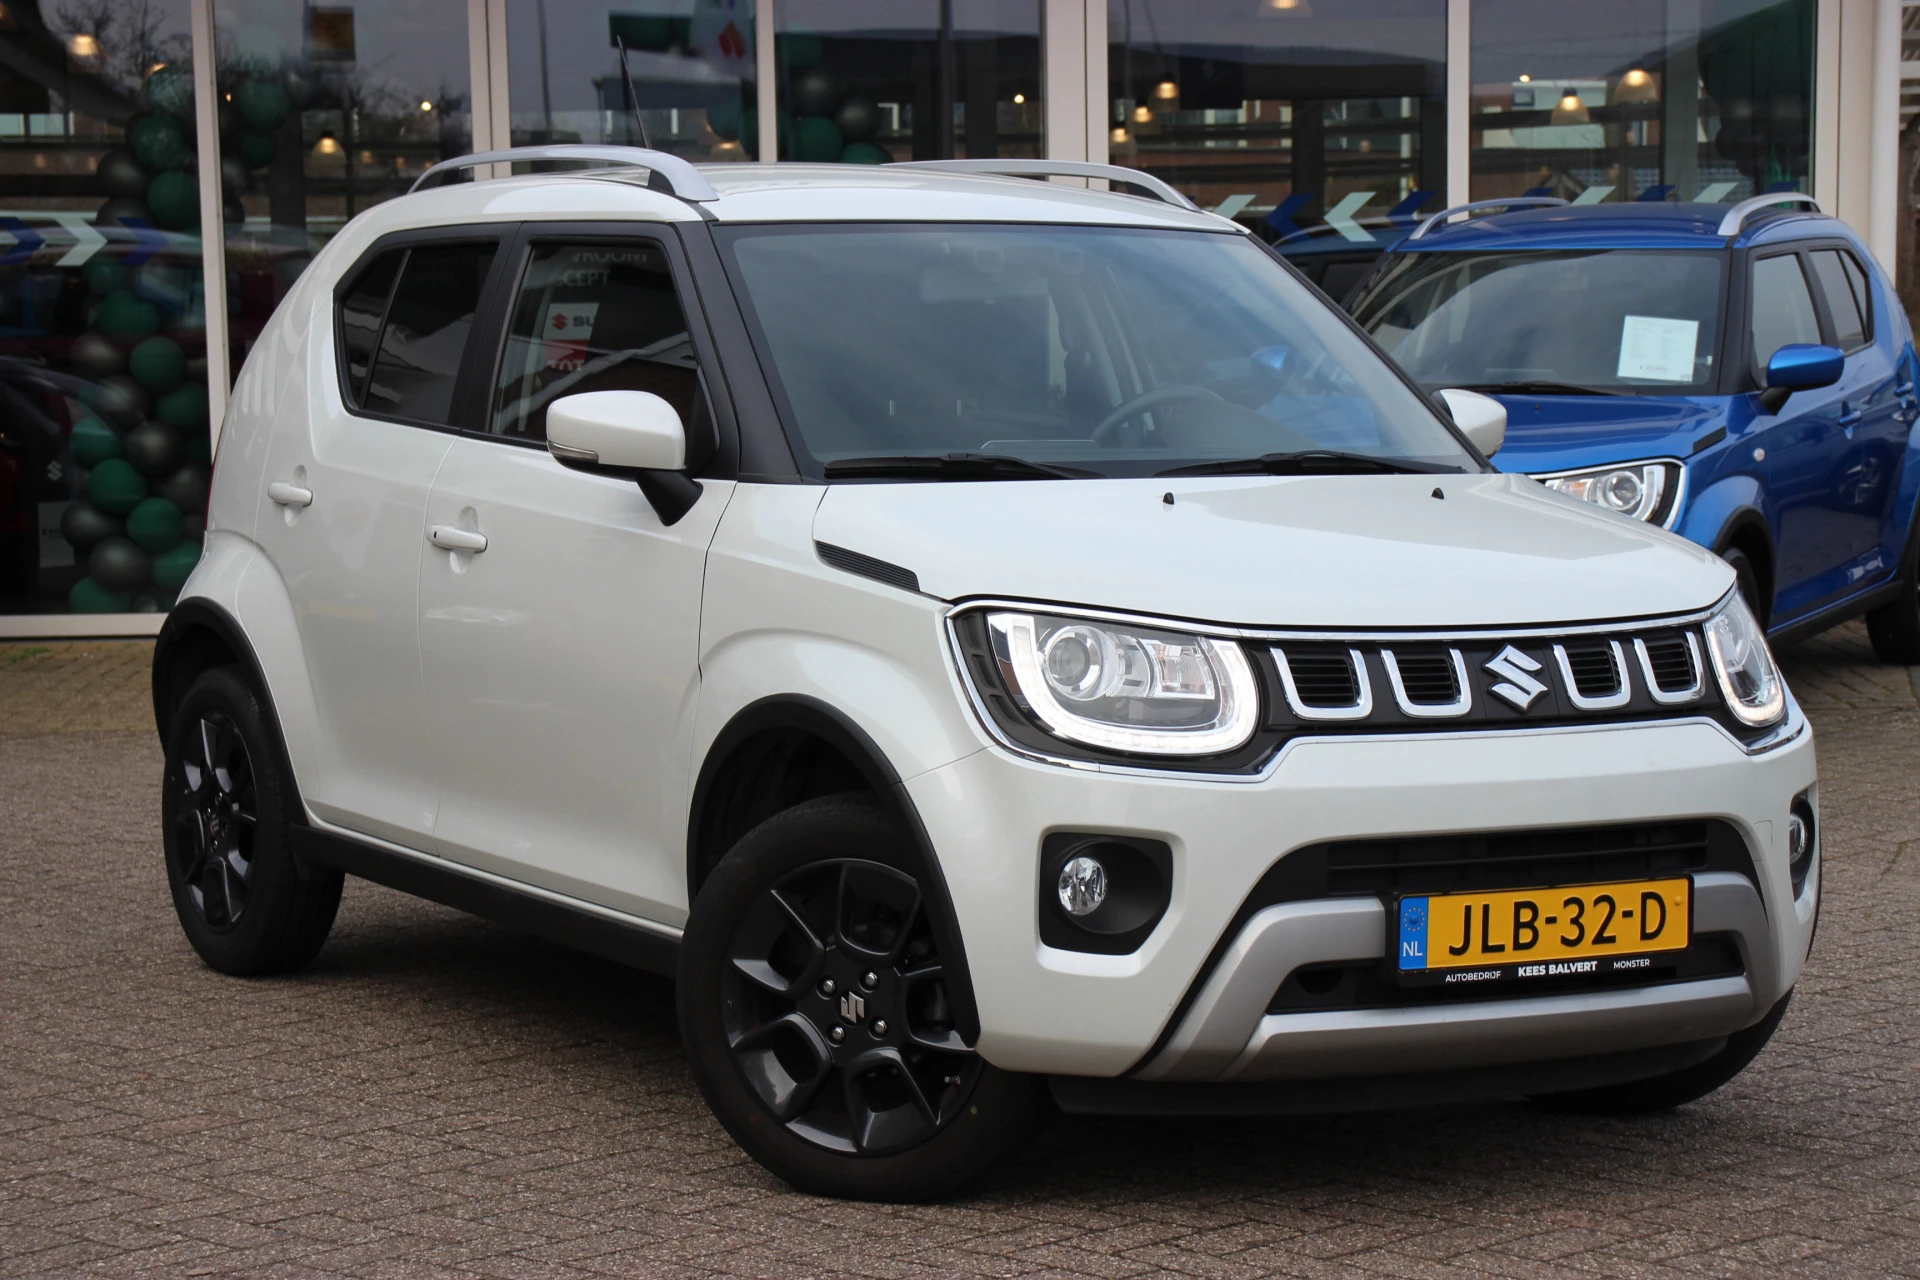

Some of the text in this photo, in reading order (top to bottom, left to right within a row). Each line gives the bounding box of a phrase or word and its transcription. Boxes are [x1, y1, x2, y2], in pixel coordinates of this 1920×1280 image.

[1449, 890, 1667, 956] JLB-32-D
[1403, 941, 1423, 958] NL
[1445, 957, 1650, 983] AUTOBEDRIJF KEES BALVERT MONSTER
